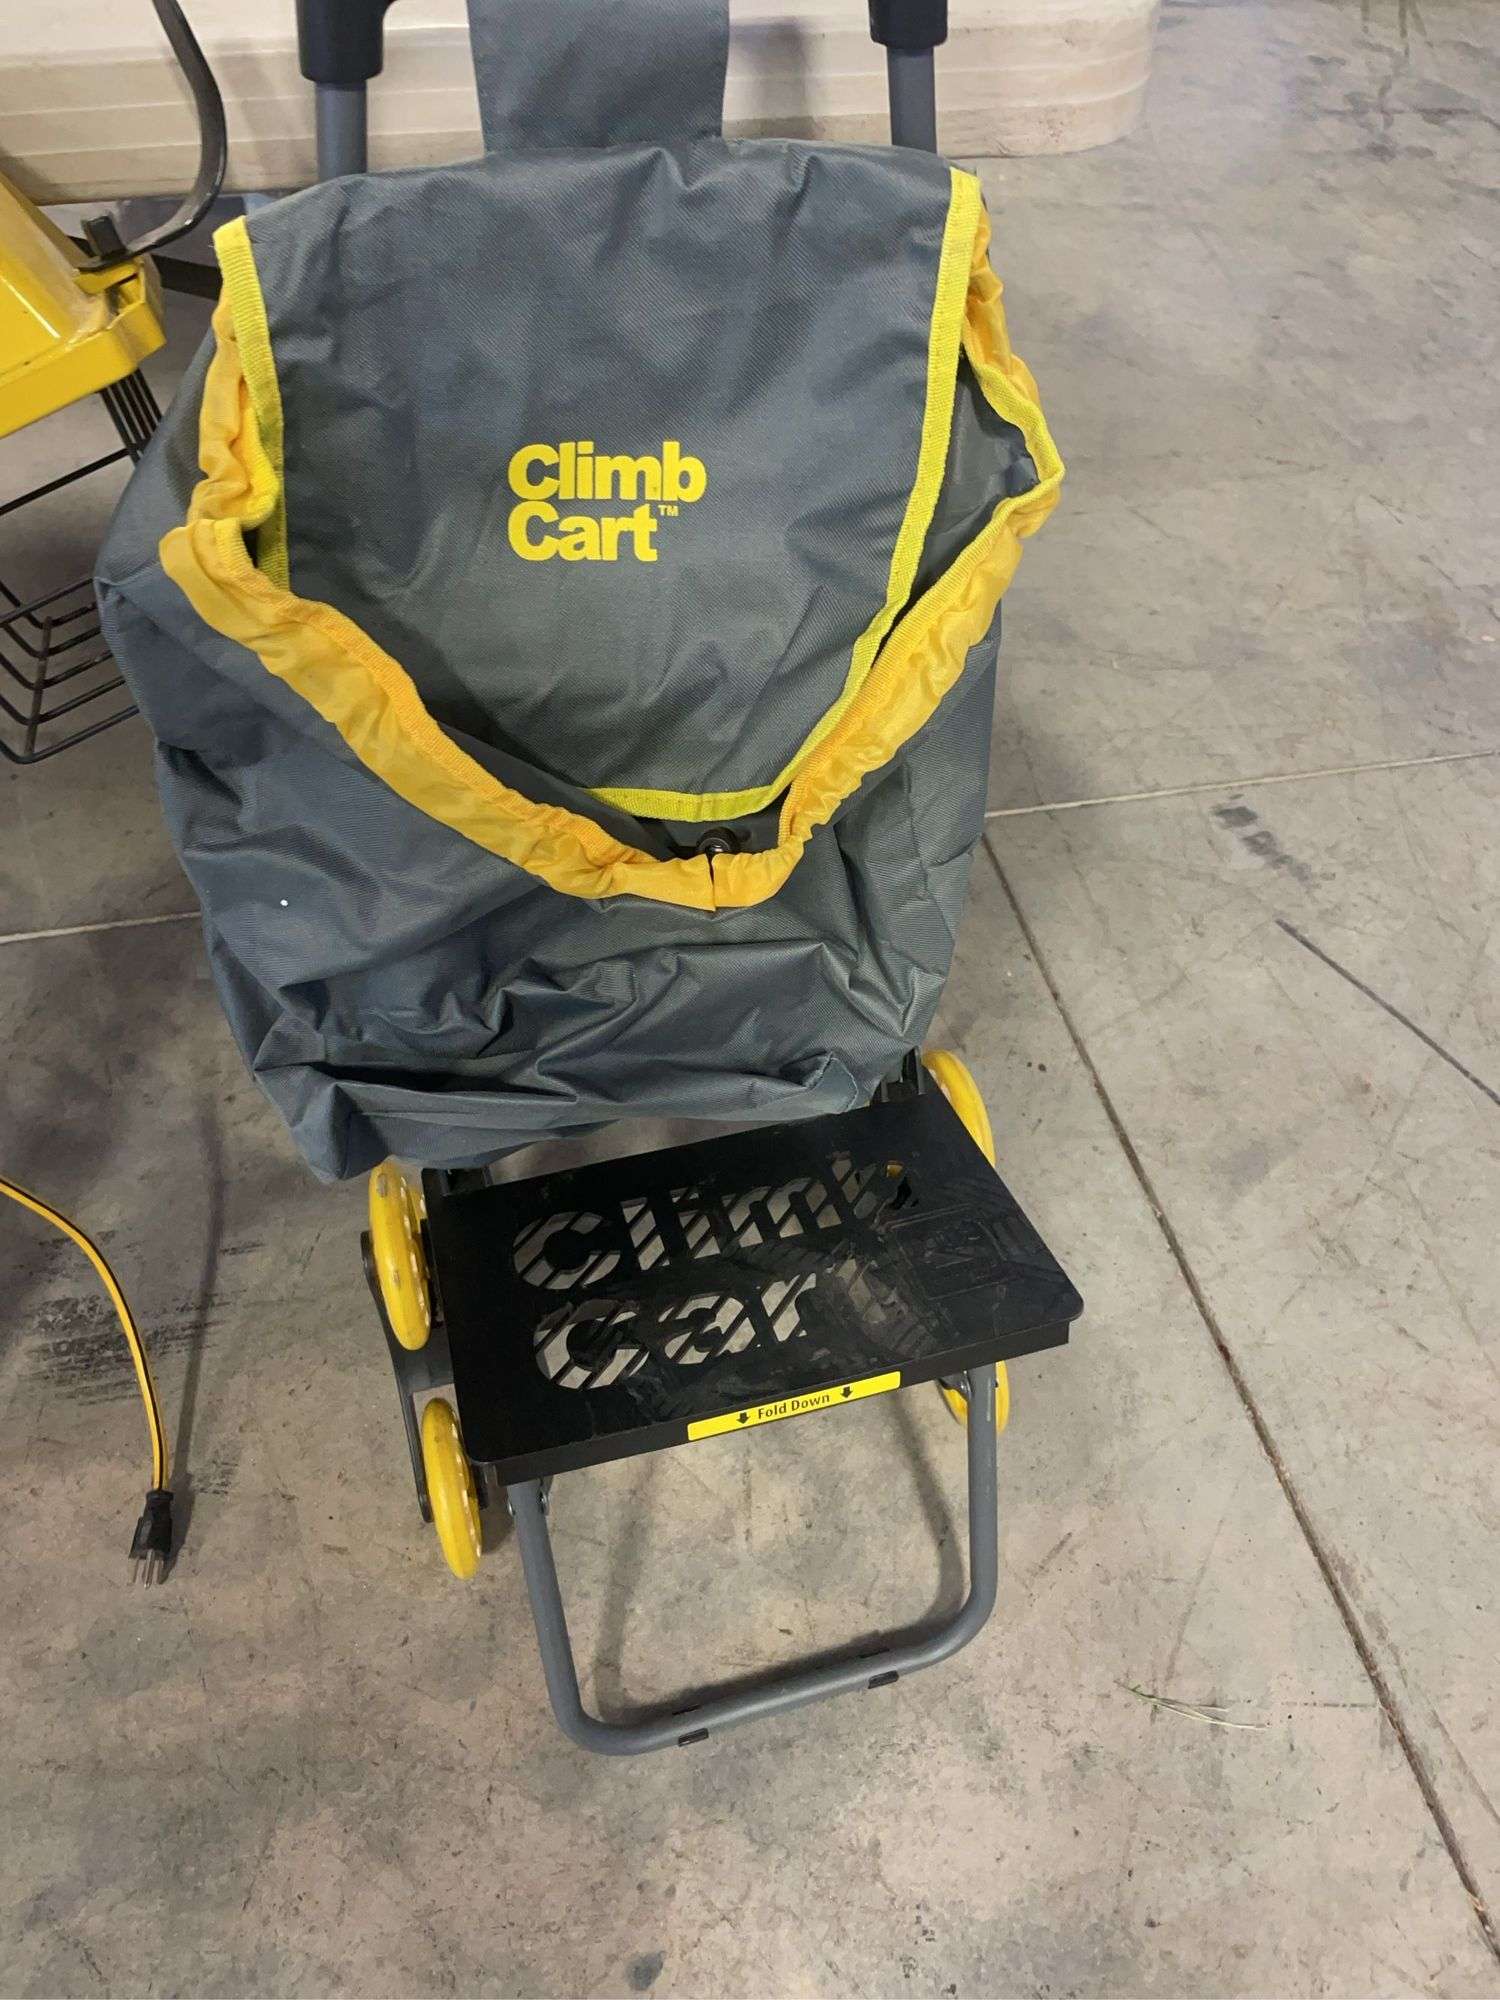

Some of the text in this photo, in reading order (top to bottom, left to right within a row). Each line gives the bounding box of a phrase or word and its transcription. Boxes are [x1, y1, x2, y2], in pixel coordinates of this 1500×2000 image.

[508, 441, 707, 502] Climb
[508, 500, 658, 561] Cart
[757, 1393, 831, 1420] Fold Down
